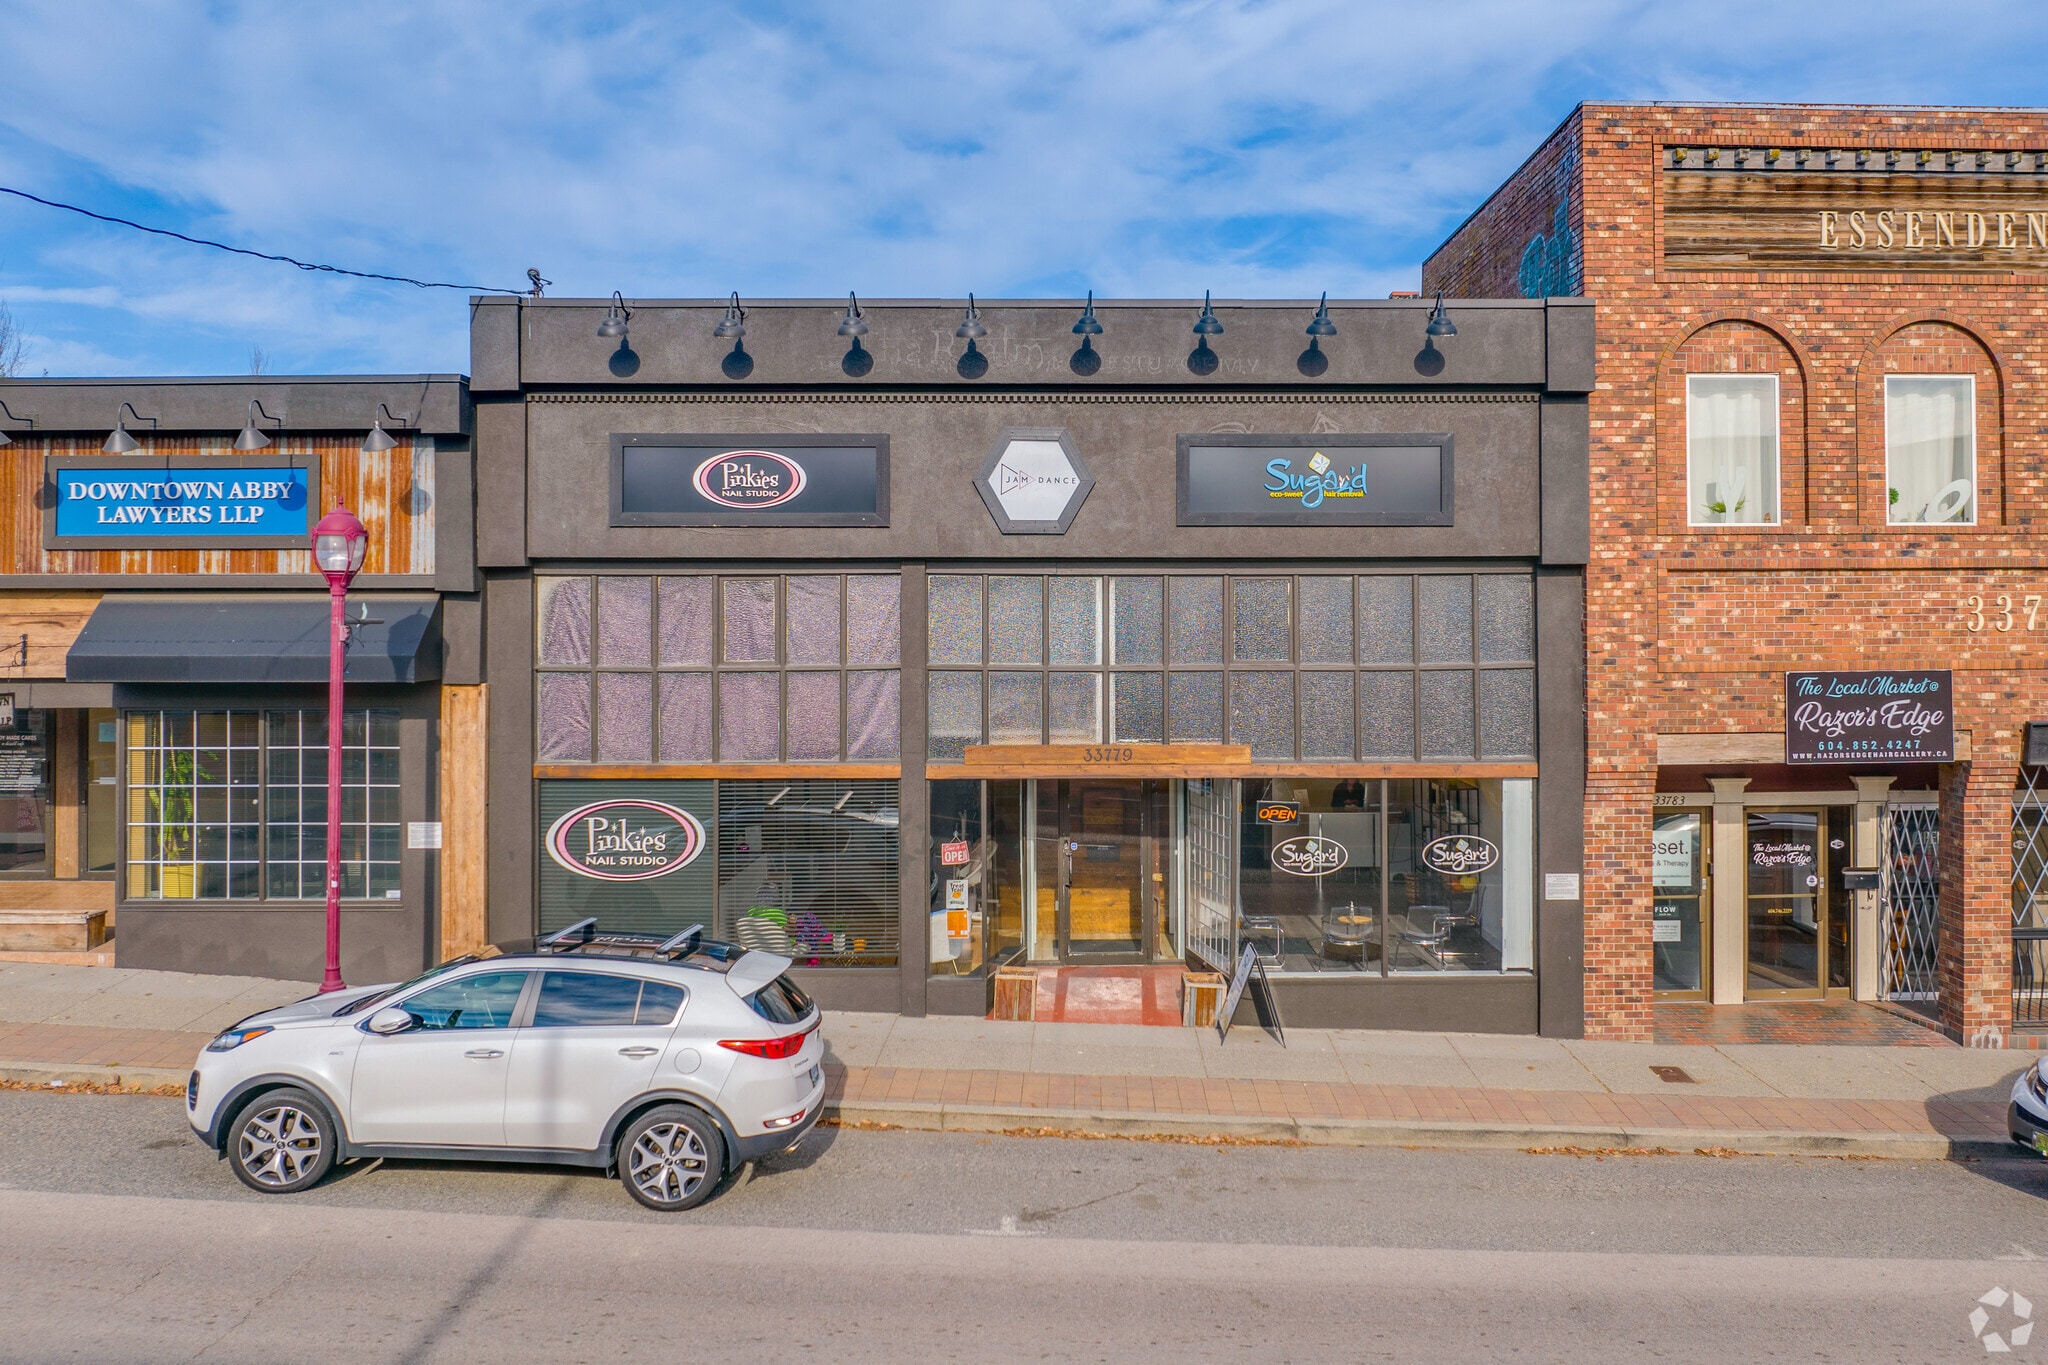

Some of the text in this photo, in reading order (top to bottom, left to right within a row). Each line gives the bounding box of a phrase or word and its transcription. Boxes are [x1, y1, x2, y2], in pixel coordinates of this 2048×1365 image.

[1819, 211, 2048, 249] ESSENDEN
[720, 462, 779, 490] Pinkies
[1264, 458, 1367, 508] Sugar'd
[68, 482, 293, 500] DOWNTOWN ABBY
[1324, 490, 1336, 498] hair
[1337, 490, 1364, 498] removal
[97, 506, 264, 524] LAWYERS LLP
[1967, 595, 2042, 632] 337
[1796, 676, 1939, 698] The Local Market @
[1794, 699, 1945, 738] Razor's Edge
[1818, 740, 1921, 751] 604.852.4247
[1083, 748, 1133, 762] 33779
[1792, 751, 1948, 759] WWW.RAZORSEDGEHAIRGALLERY.CA
[1653, 795, 1686, 805] 33783
[1259, 808, 1297, 820] OPEN
[583, 817, 666, 855] Pinkies
[586, 856, 667, 865] NAIL STUDIO
[944, 851, 968, 862] OPEN
[1281, 844, 1338, 872] Sugar'd
[1432, 843, 1489, 871] Sugar'd
[1754, 852, 1812, 866] Razor's Edge
